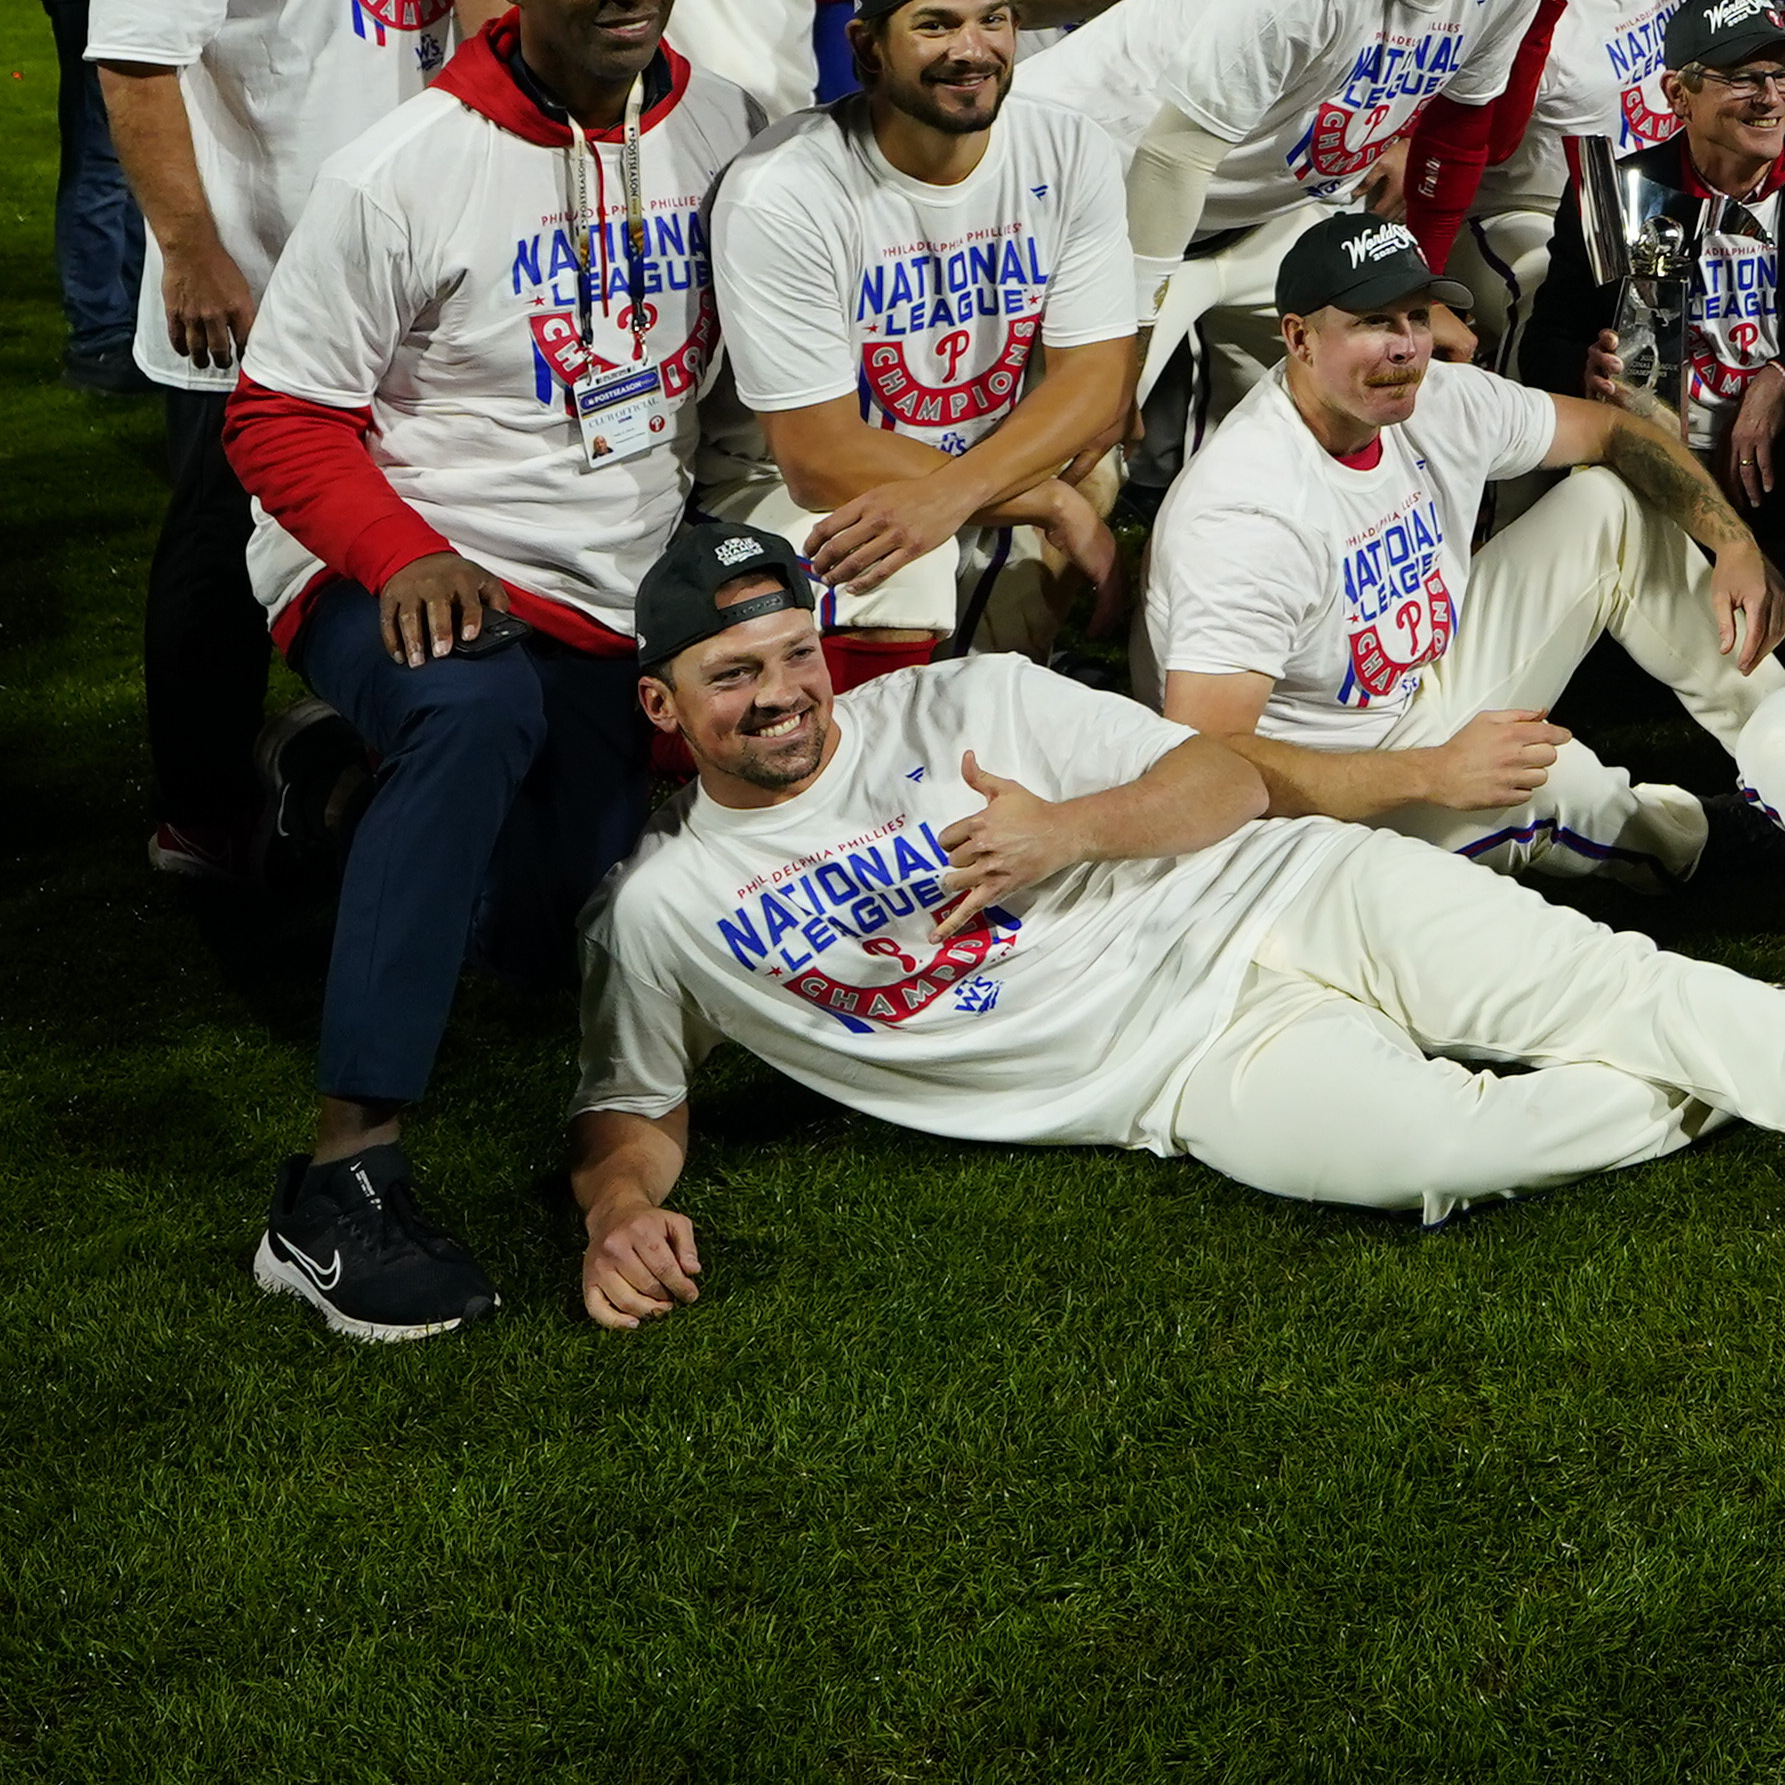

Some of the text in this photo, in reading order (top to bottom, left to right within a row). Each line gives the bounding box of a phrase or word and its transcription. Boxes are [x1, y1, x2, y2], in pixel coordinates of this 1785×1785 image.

[857, 236, 1050, 321] NATIONAL
[886, 287, 1022, 335] LEAGUE
[779, 875, 945, 972] LEAGUE
